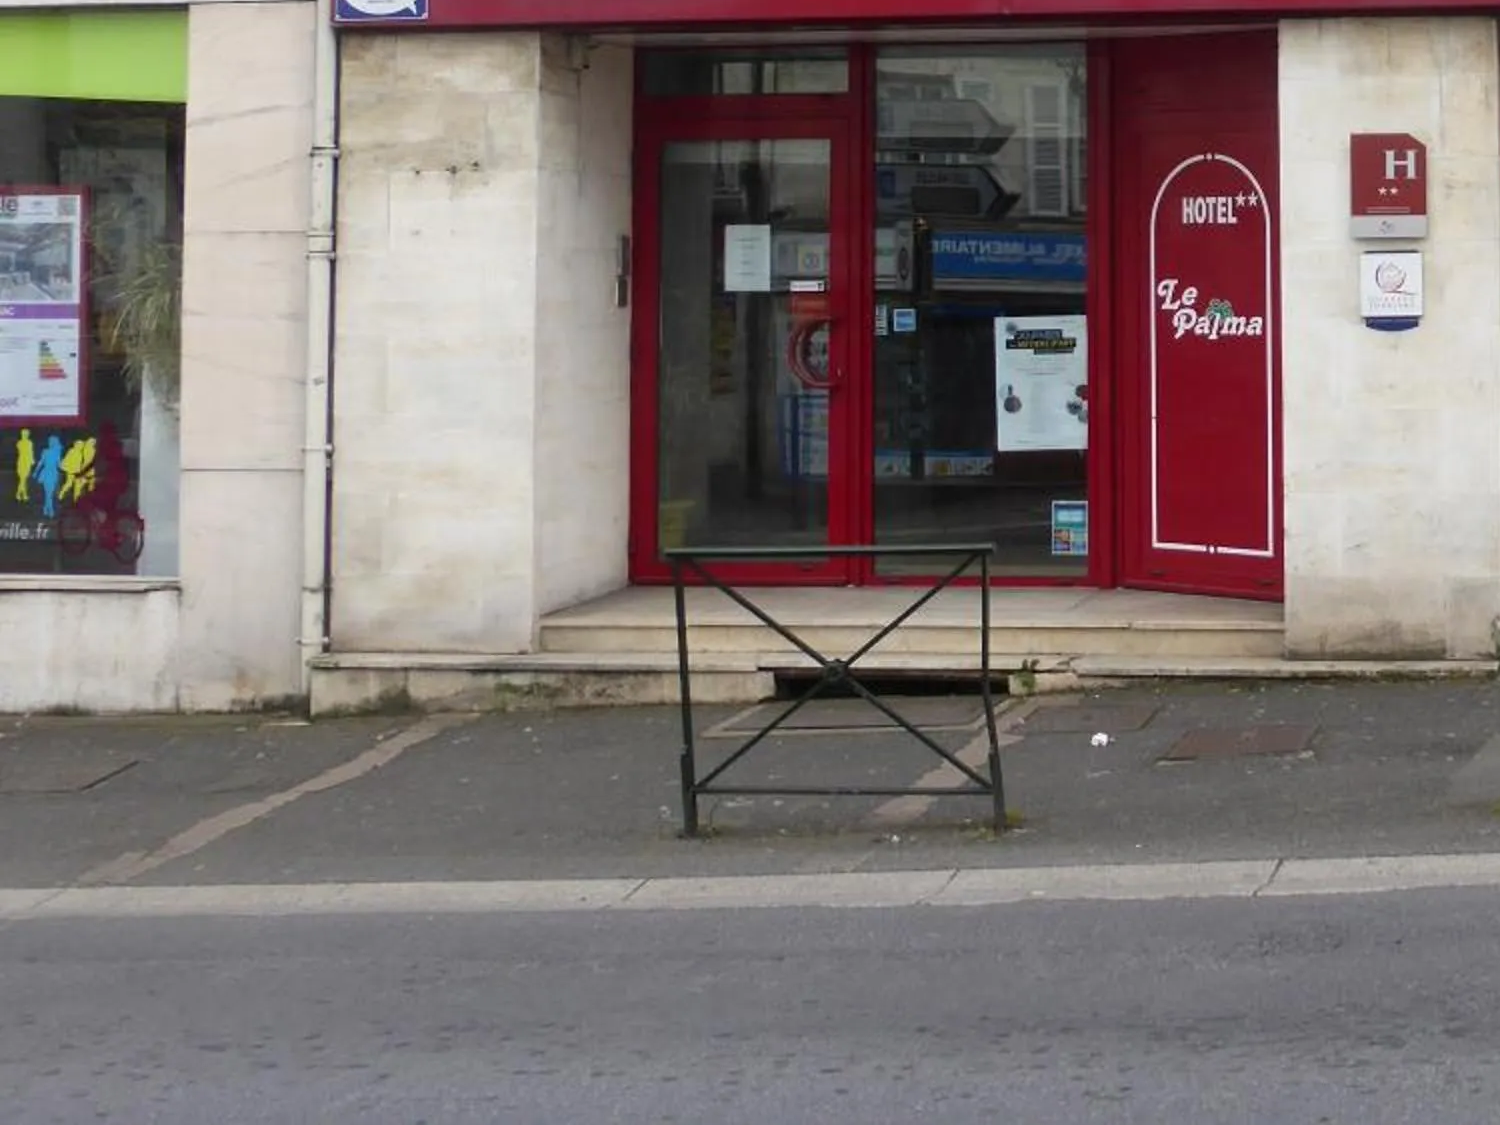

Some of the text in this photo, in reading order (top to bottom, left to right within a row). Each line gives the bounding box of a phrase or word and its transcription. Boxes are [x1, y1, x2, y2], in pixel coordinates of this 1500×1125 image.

[1384, 149, 1418, 180] H
[1182, 196, 1238, 224] HOTEL
[1157, 278, 1199, 310] Le
[1172, 308, 1263, 340] Palma
